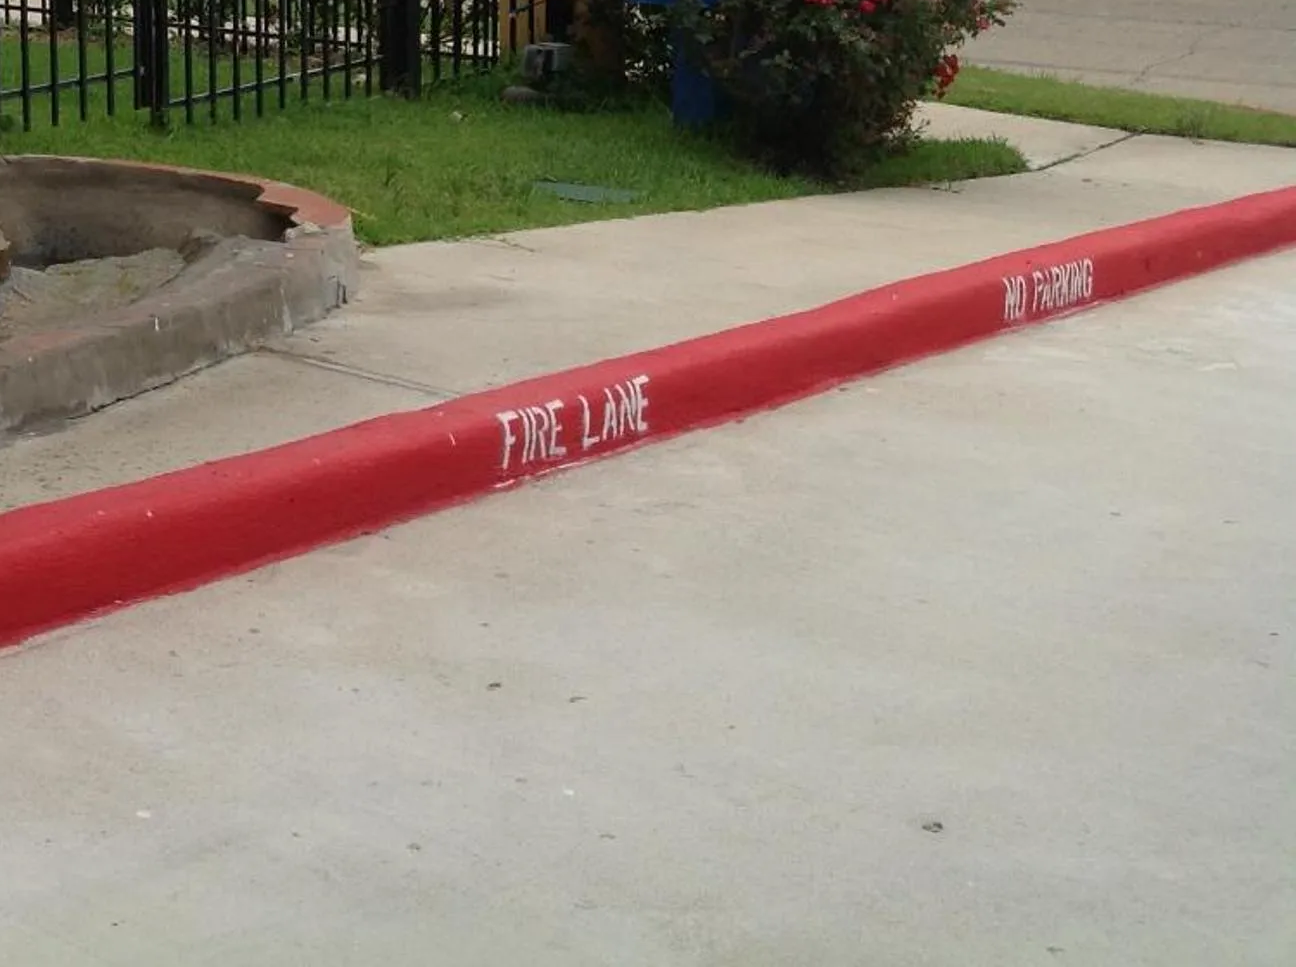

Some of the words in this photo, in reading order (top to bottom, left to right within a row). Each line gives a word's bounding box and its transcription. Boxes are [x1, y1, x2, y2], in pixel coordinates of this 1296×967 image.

[1002, 275, 1027, 321] NO
[1032, 258, 1093, 312] PARKING
[496, 399, 567, 469] FIRE
[577, 375, 649, 450] LANE
